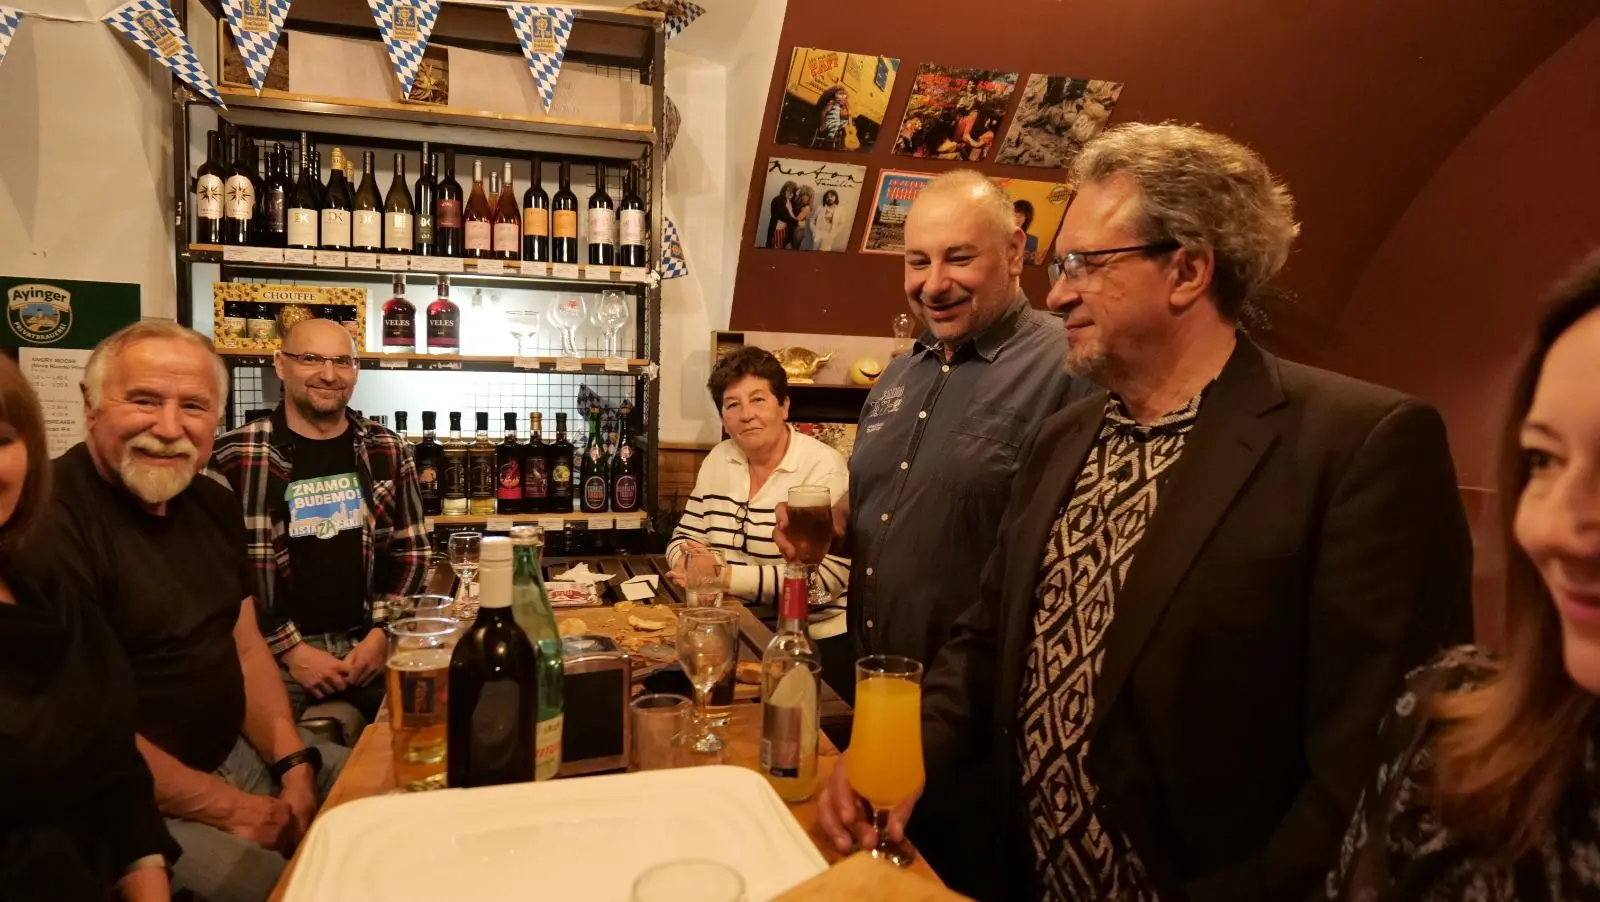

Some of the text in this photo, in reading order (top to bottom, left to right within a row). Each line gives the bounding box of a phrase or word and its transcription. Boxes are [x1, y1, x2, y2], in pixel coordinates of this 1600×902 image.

[12, 286, 68, 303] Ayinger
[262, 290, 317, 301] CHOUFFE
[385, 319, 411, 327] VELES
[429, 319, 455, 328] VELES
[292, 477, 350, 497] ZNAMO
[295, 489, 361, 509] BUDEMO!
